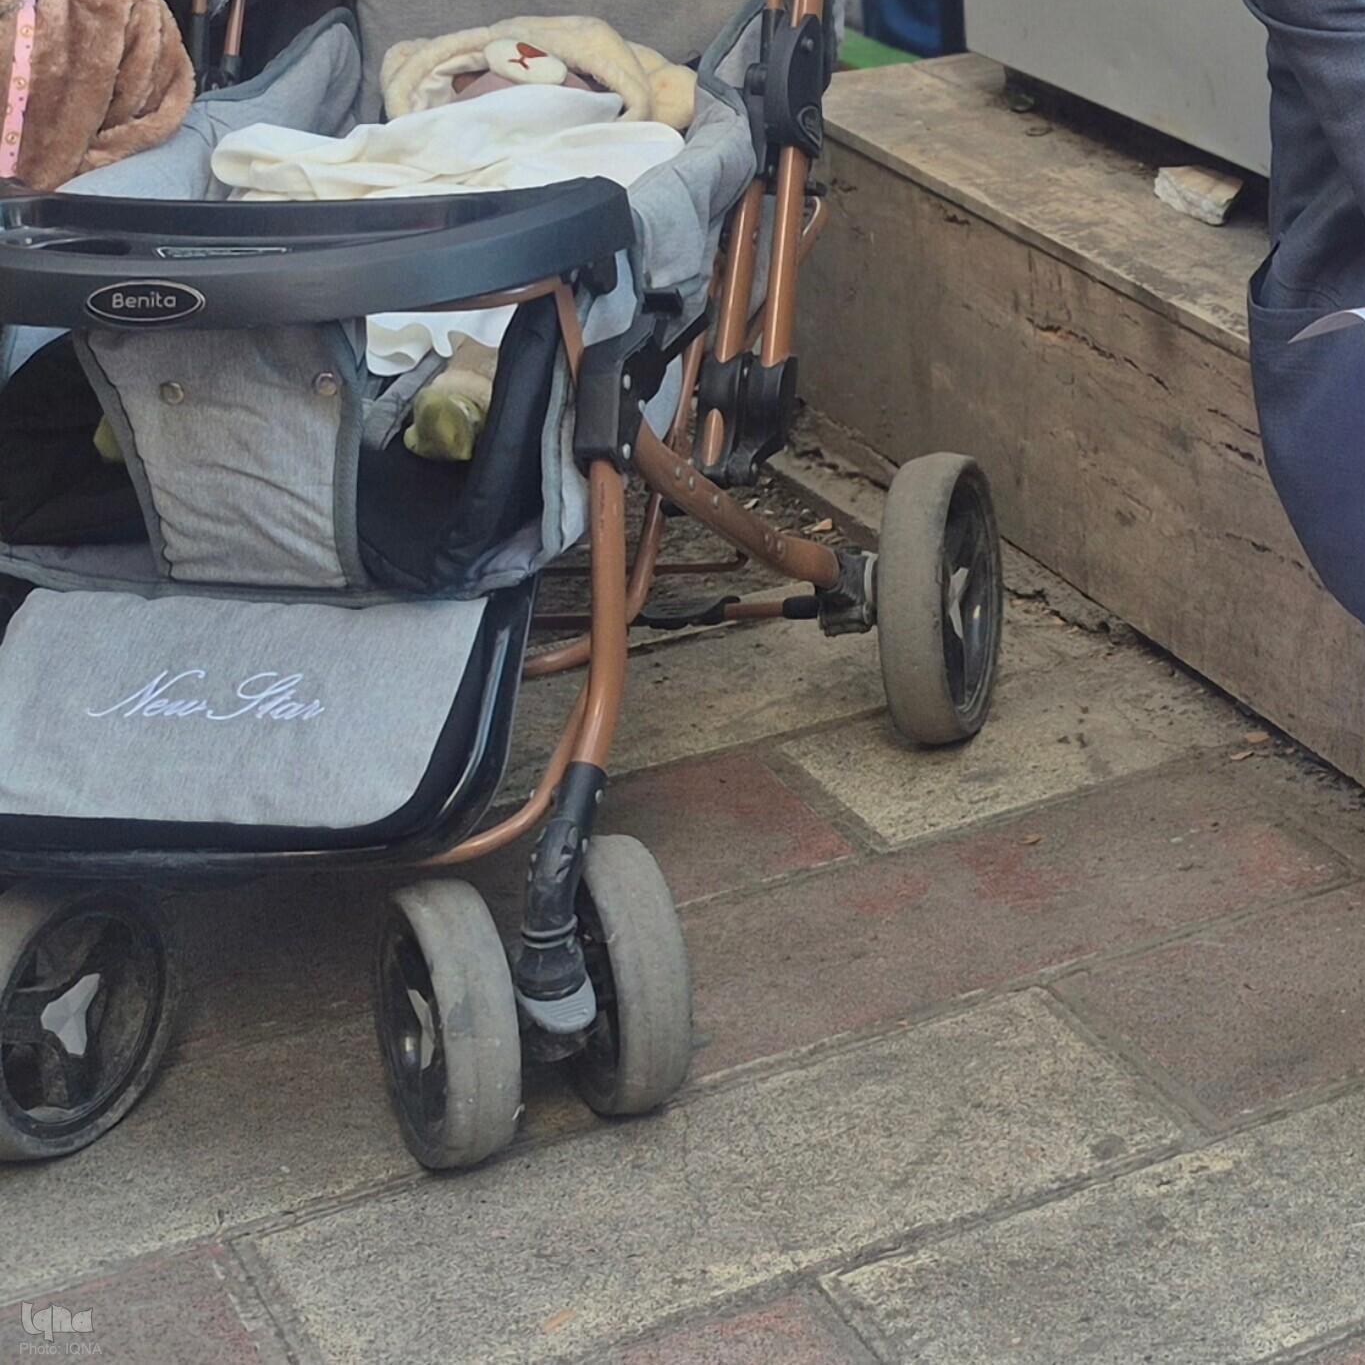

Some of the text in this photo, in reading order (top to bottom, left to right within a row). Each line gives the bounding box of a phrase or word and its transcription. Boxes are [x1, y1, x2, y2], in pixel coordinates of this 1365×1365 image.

[111, 290, 177, 309] Benita
[87, 669, 325, 721] New Star
